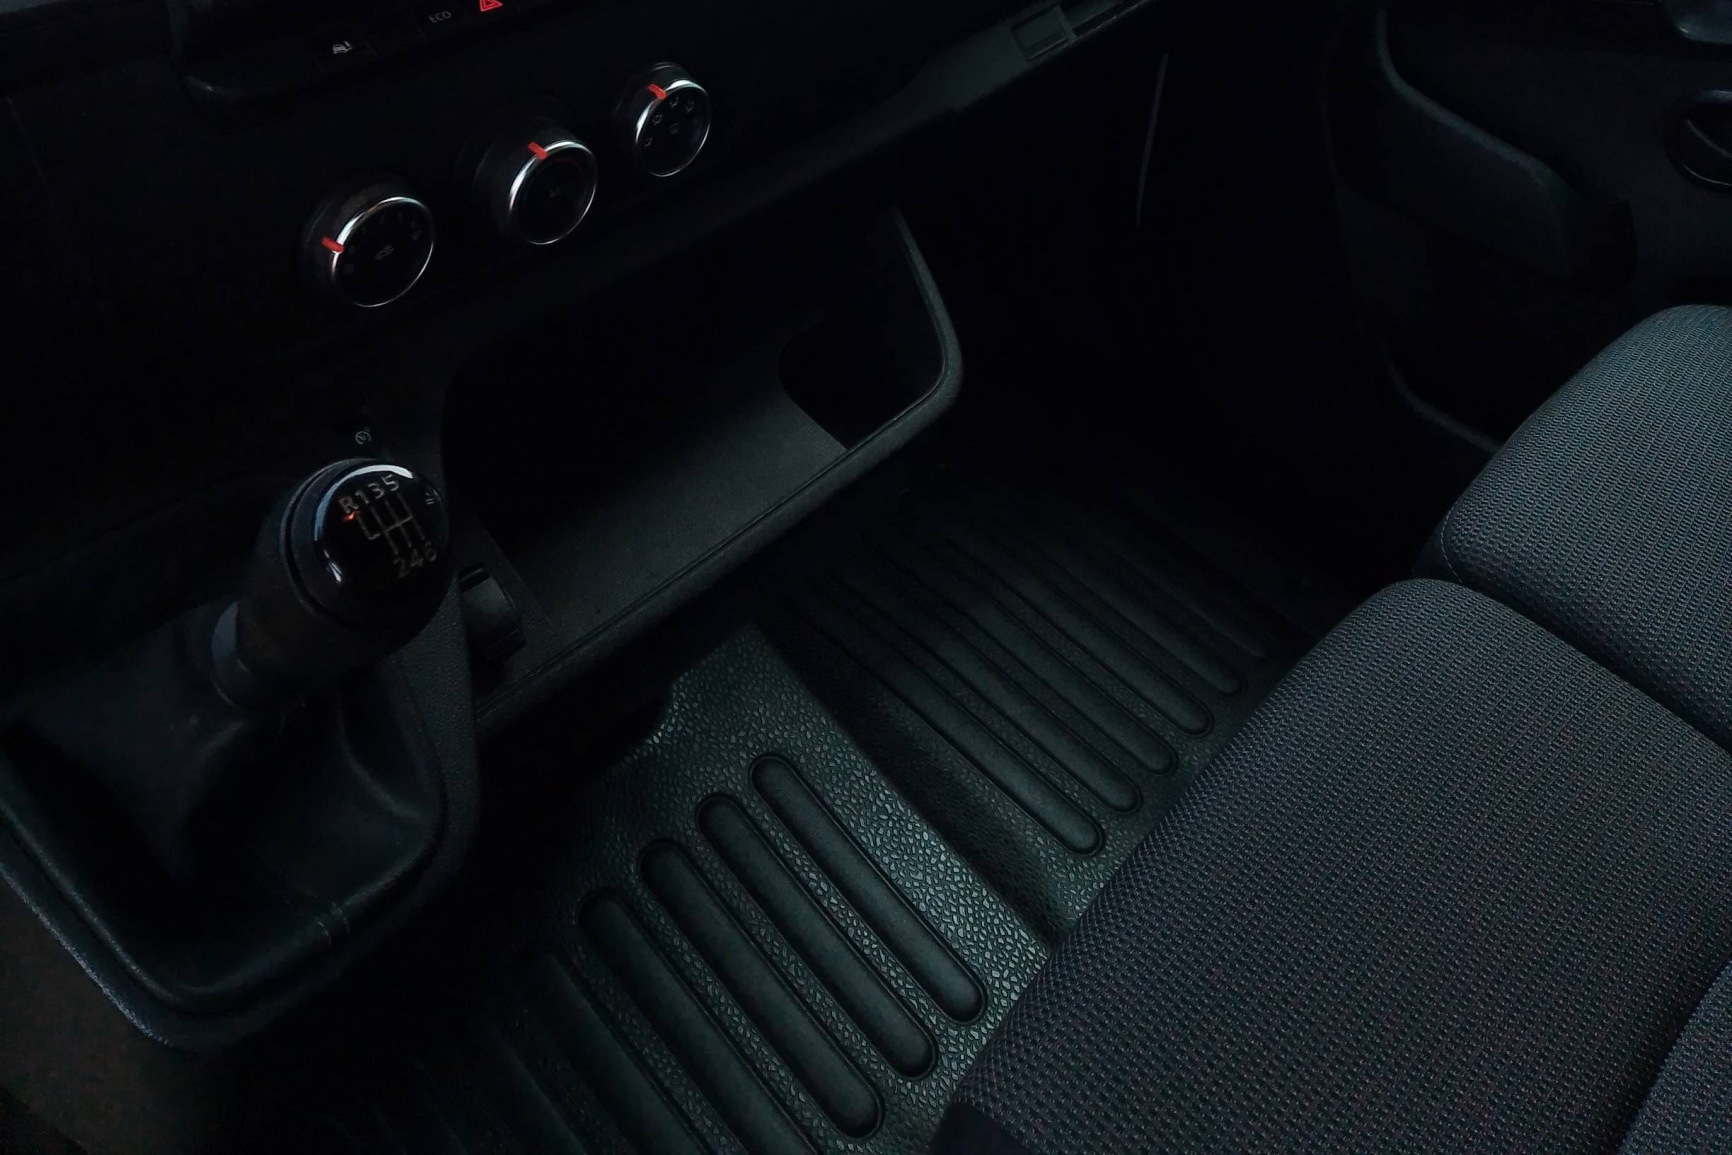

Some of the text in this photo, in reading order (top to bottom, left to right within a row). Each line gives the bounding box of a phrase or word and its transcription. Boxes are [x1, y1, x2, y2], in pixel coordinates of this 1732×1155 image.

[428, 11, 452, 24] ECO
[339, 473, 400, 515] R 1 3 5
[393, 556, 411, 579] 2
[410, 547, 424, 567] 4
